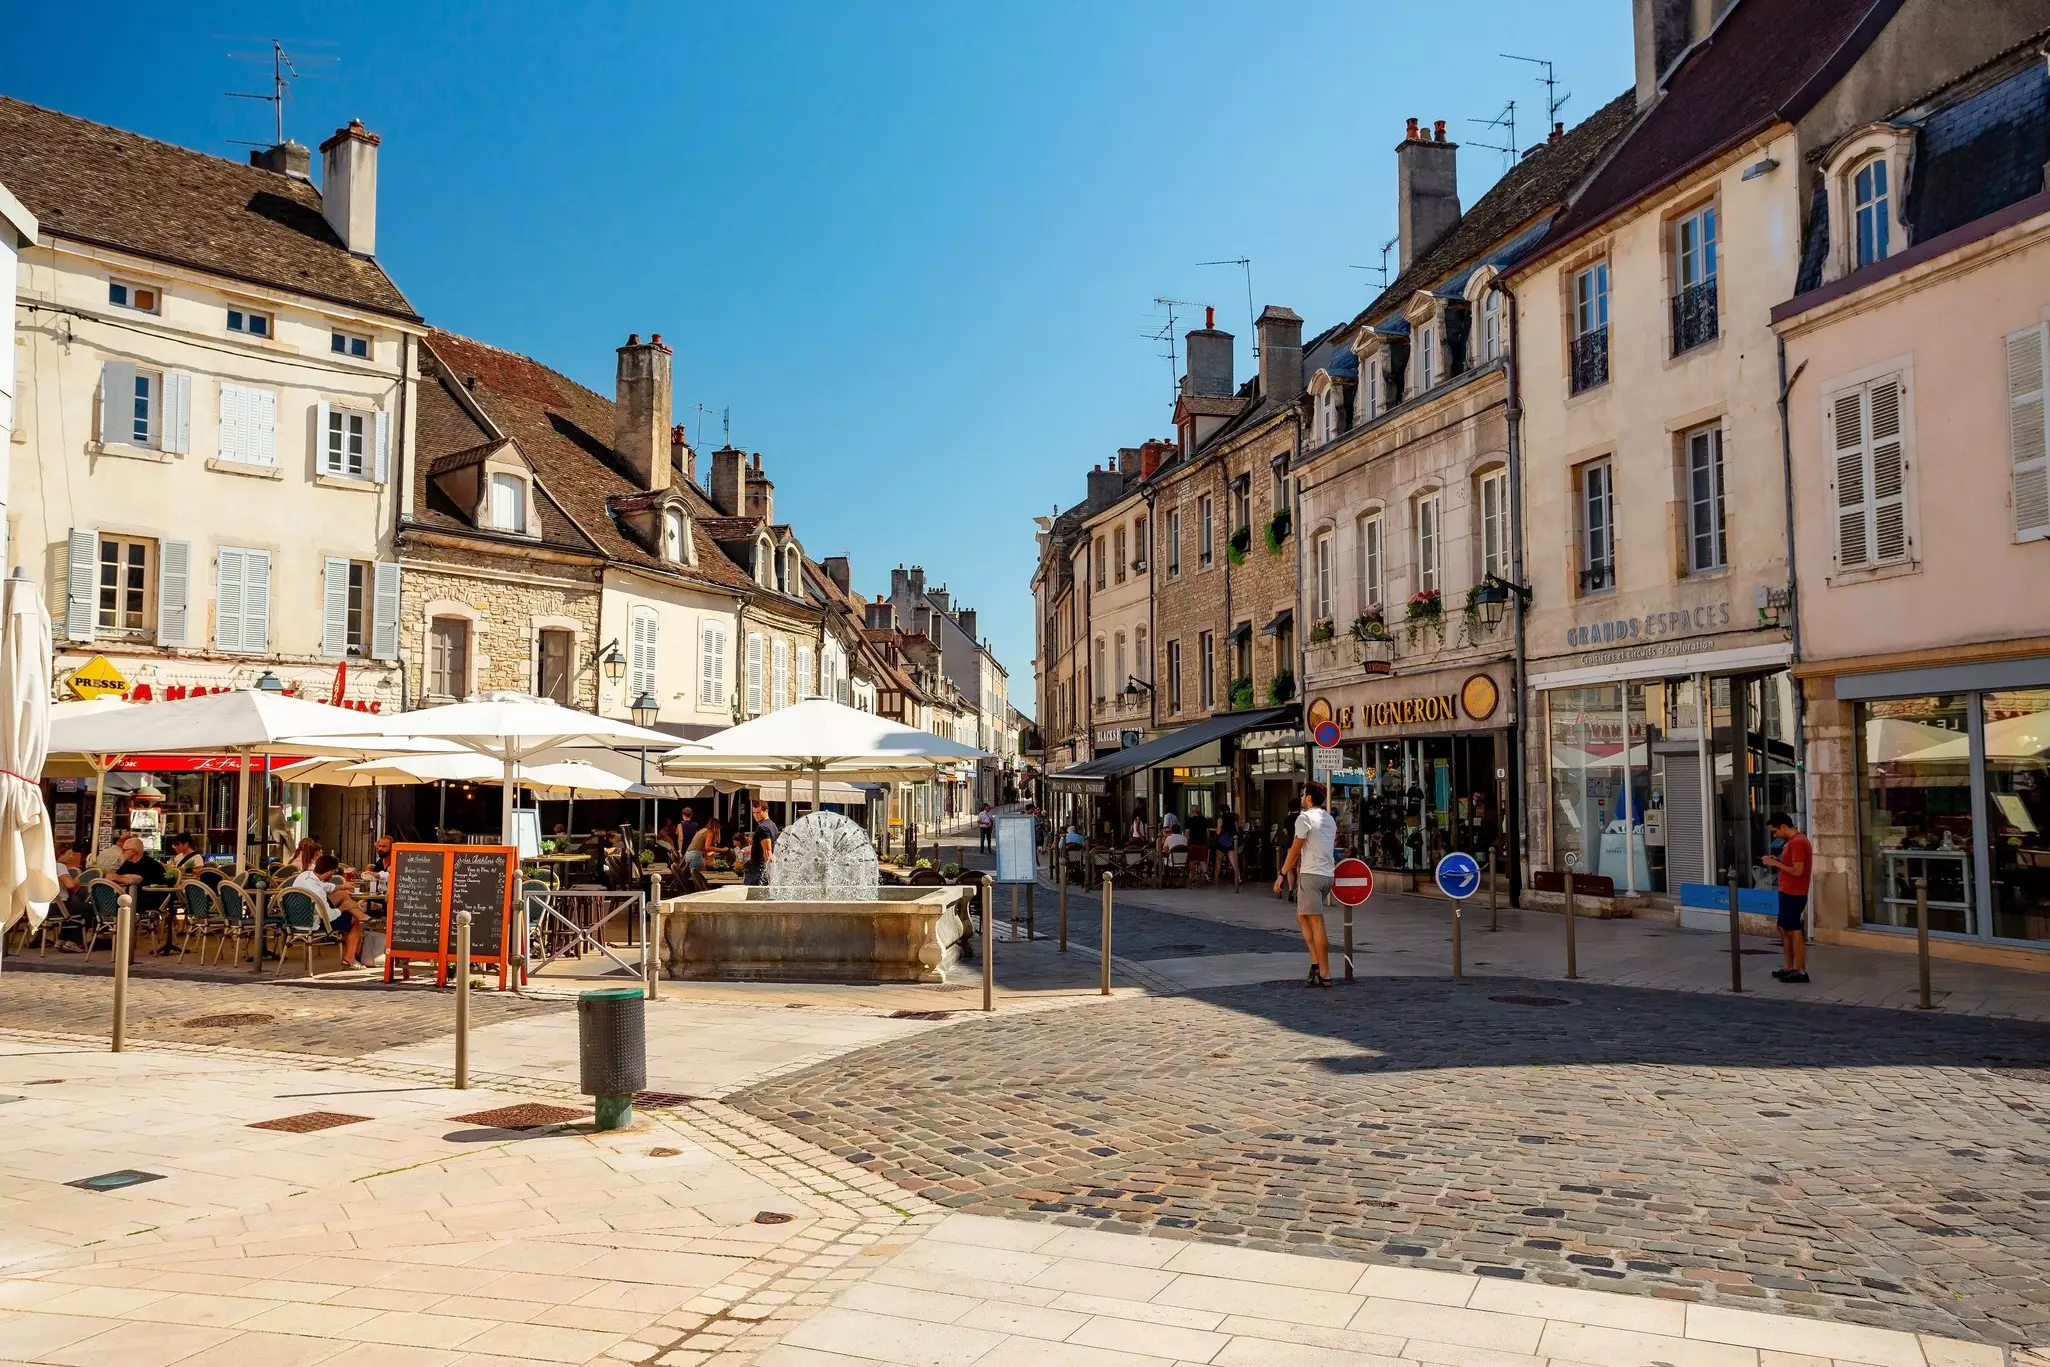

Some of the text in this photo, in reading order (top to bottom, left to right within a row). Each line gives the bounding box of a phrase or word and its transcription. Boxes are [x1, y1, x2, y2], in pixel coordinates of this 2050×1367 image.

[1567, 602, 1729, 647] GRANDS ESPACES
[1617, 652, 1625, 661] et
[1627, 647, 1656, 659] circuits
[1658, 639, 1715, 656] d'exploration
[74, 677, 126, 690] PRESSE
[1361, 694, 1457, 727] VIGNERON
